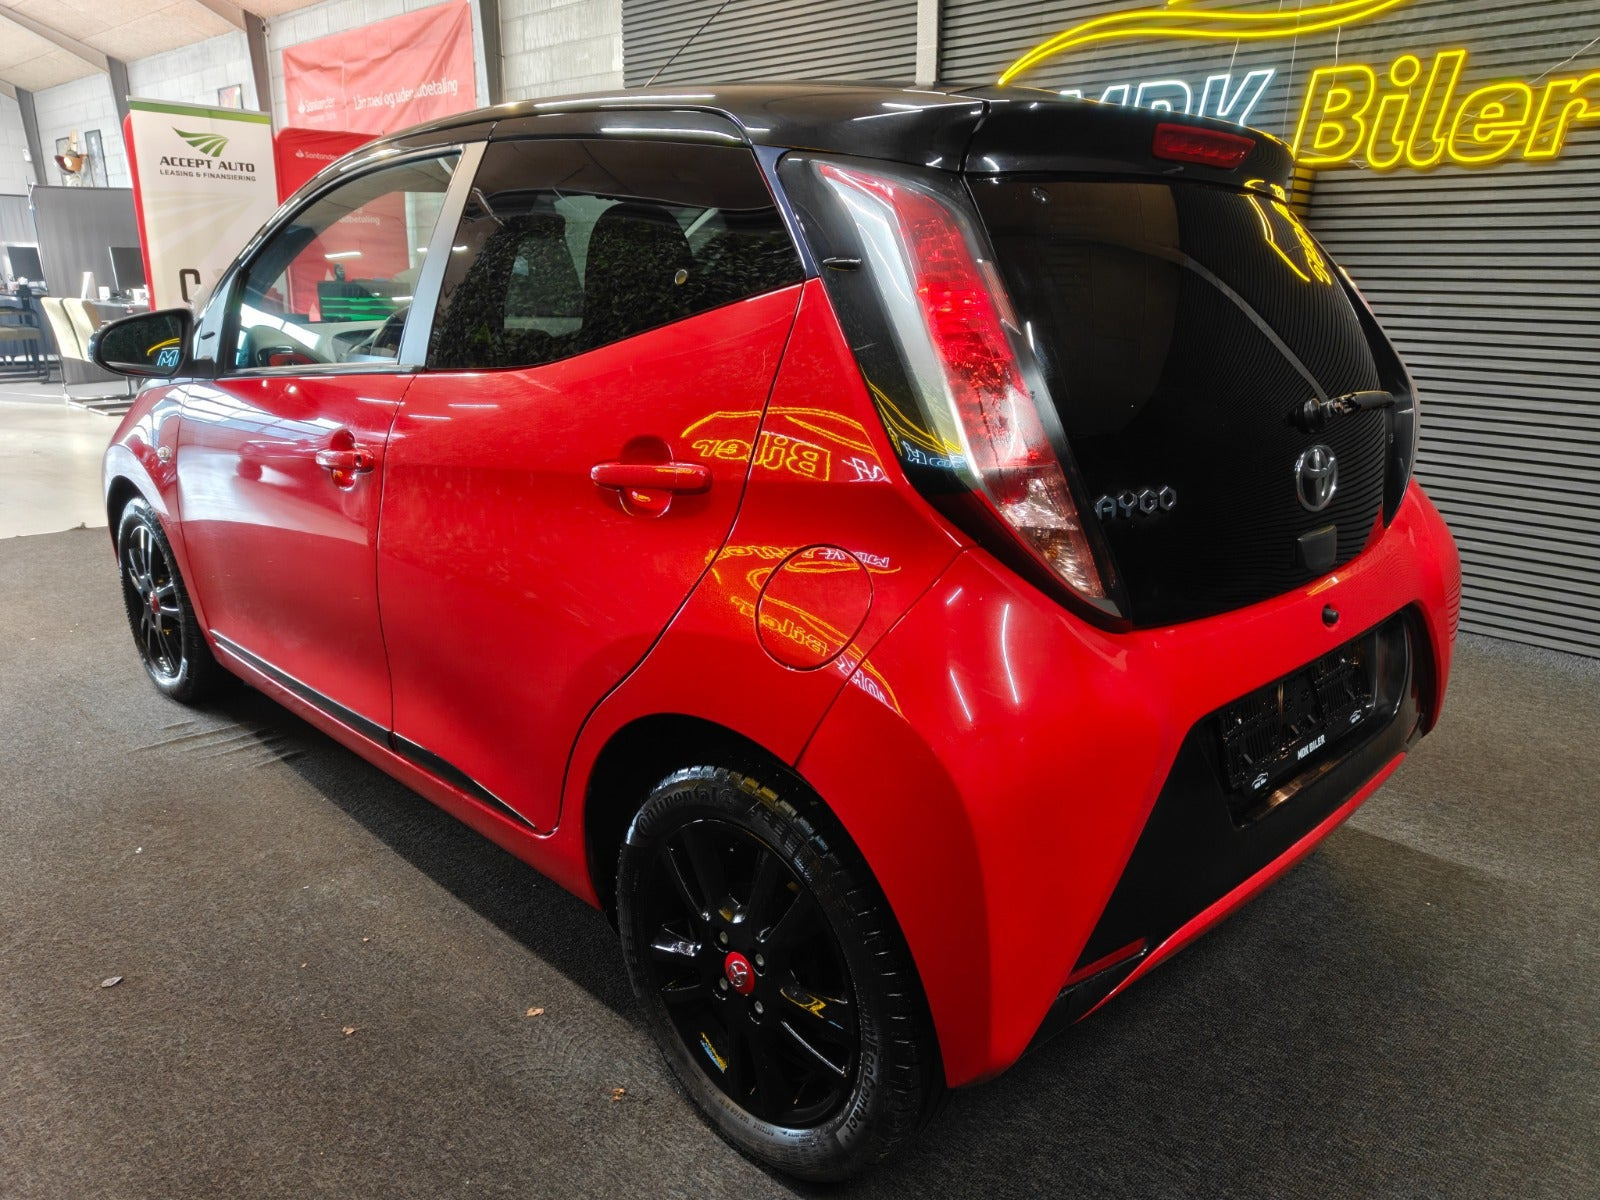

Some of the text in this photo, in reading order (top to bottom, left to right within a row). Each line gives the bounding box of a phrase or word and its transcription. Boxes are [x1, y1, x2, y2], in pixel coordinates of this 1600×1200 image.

[1293, 49, 1600, 168] Biler
[160, 156, 255, 172] ACCEPT AUTO
[160, 169, 194, 178] LEASING
[203, 173, 256, 182] FINANSIERING
[1095, 486, 1177, 520] AYGO
